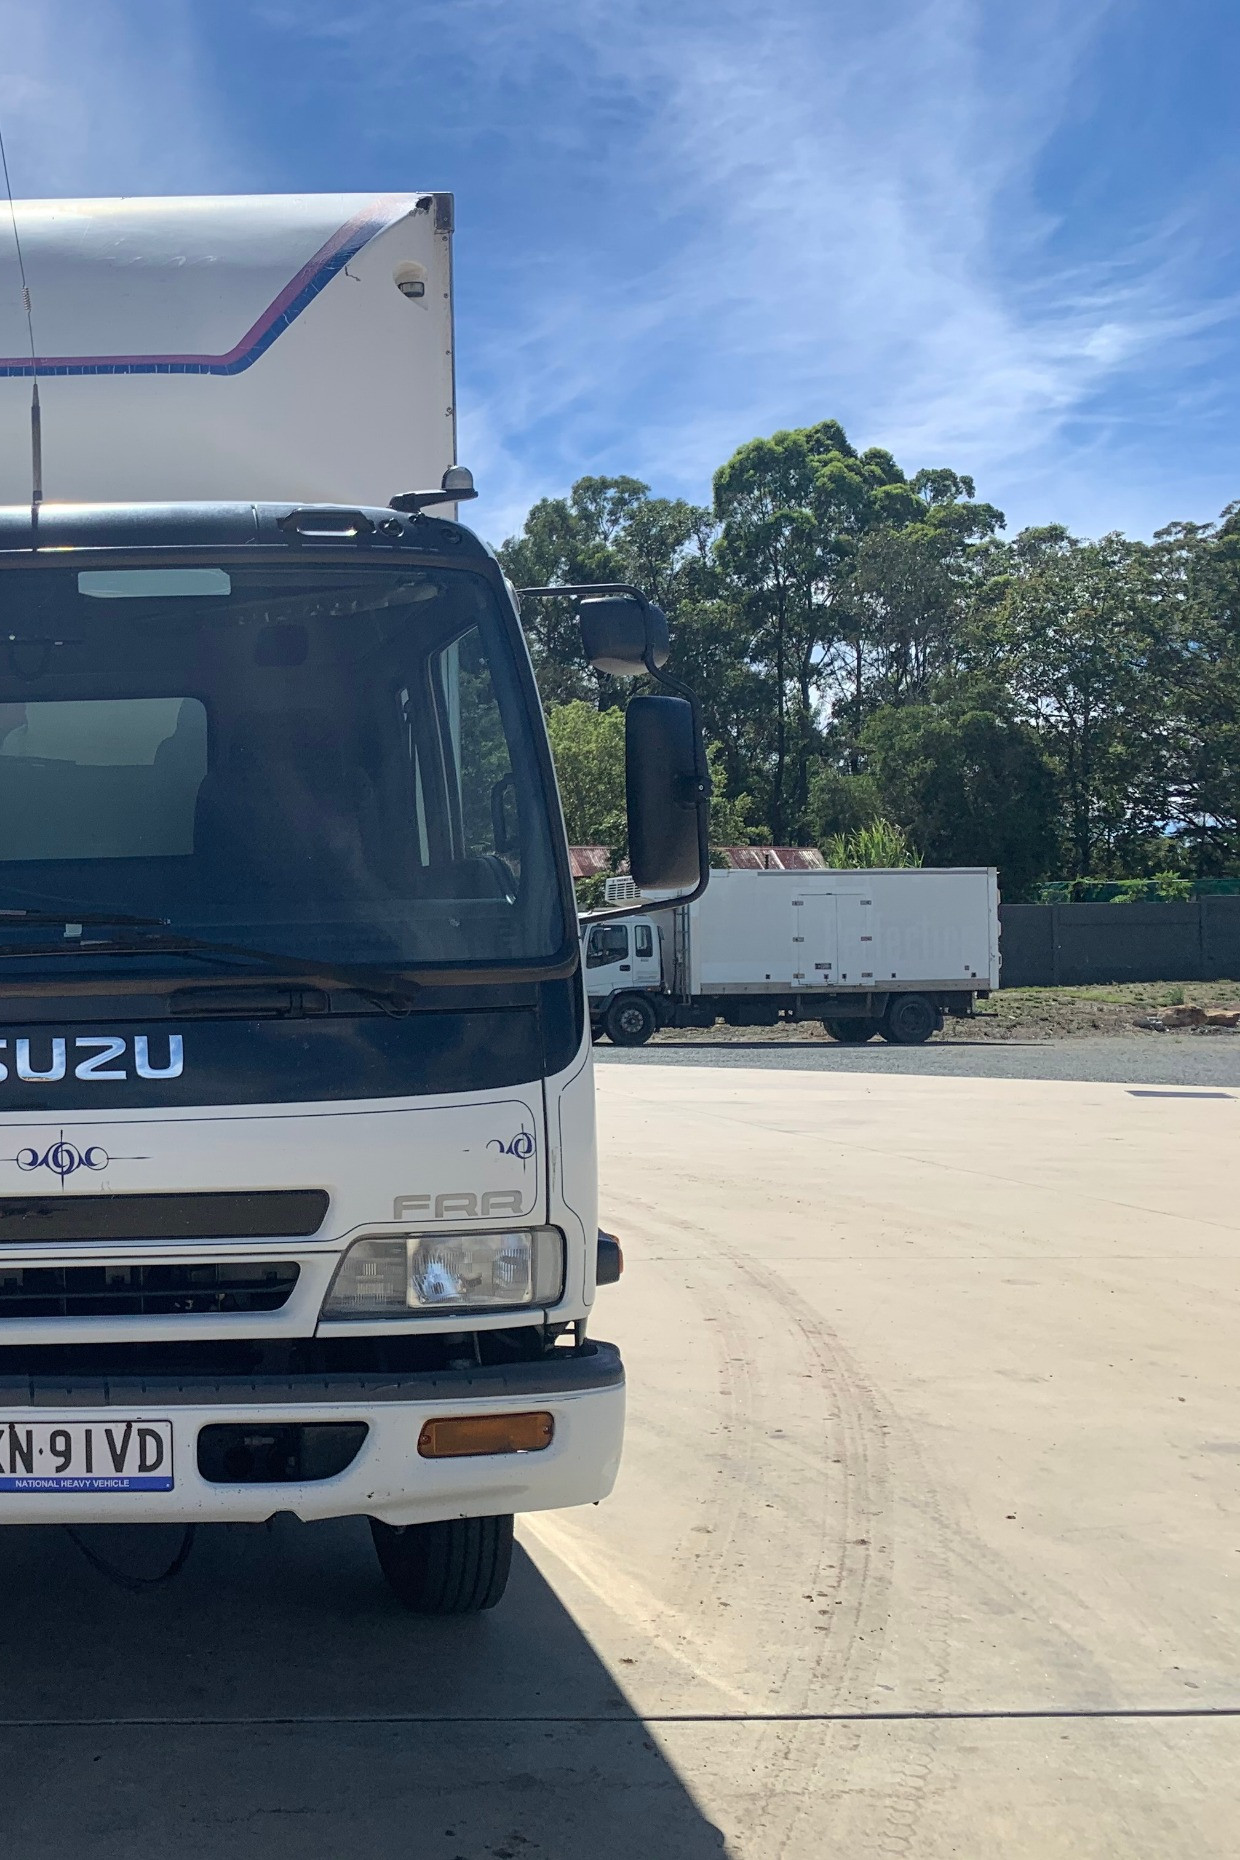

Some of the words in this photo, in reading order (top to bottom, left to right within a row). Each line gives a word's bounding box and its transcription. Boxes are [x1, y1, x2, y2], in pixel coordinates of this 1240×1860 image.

[393, 1190, 523, 1220] FRR
[15, 1479, 60, 1489] NATIONAL
[60, 1479, 92, 1488] HEAVY
[92, 1479, 130, 1488] VEHICLE
